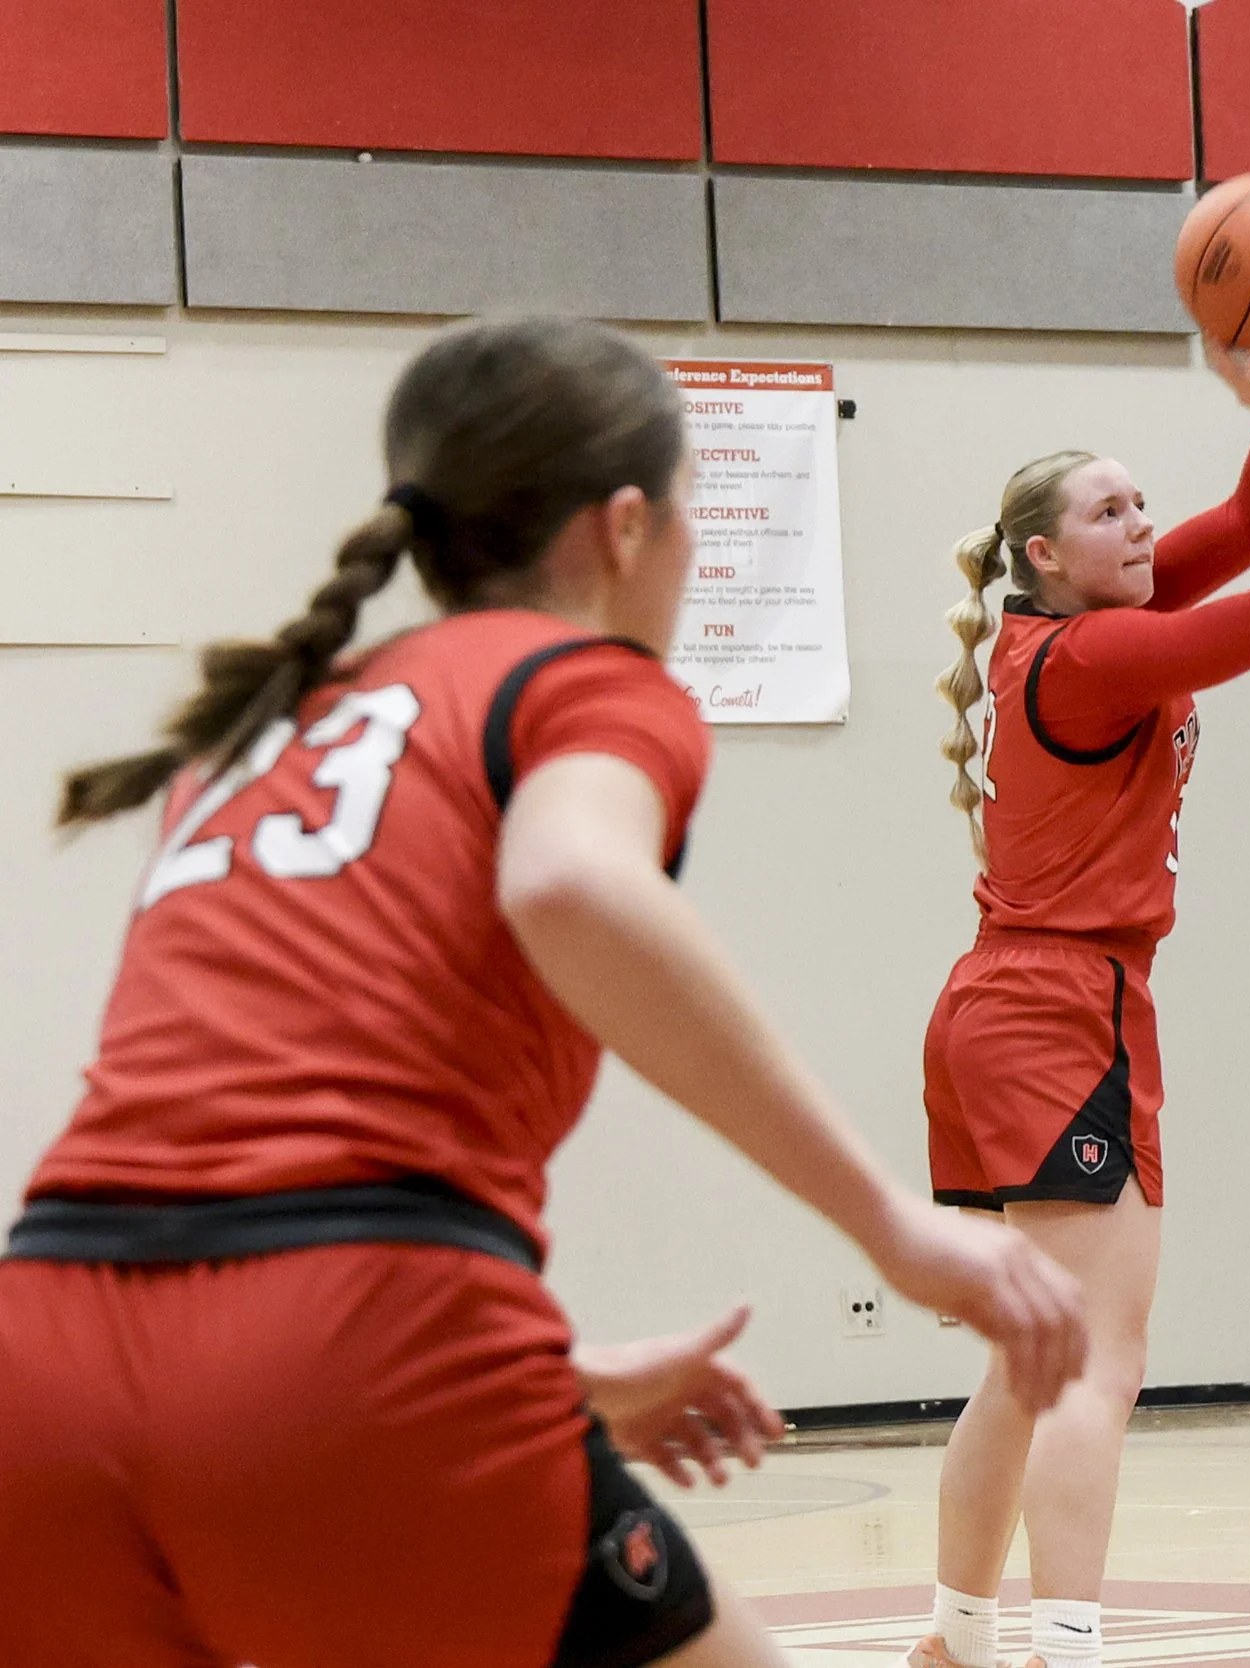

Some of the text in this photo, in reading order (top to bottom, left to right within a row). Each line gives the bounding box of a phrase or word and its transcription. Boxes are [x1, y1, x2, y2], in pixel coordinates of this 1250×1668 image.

[729, 368, 823, 387] Expectations
[684, 402, 744, 415] OSITIVE
[698, 566, 737, 579] KIND
[703, 624, 735, 637] FUN
[708, 683, 763, 708] Comets!
[135, 681, 422, 912] 23
[1082, 1142, 1099, 1163] H
